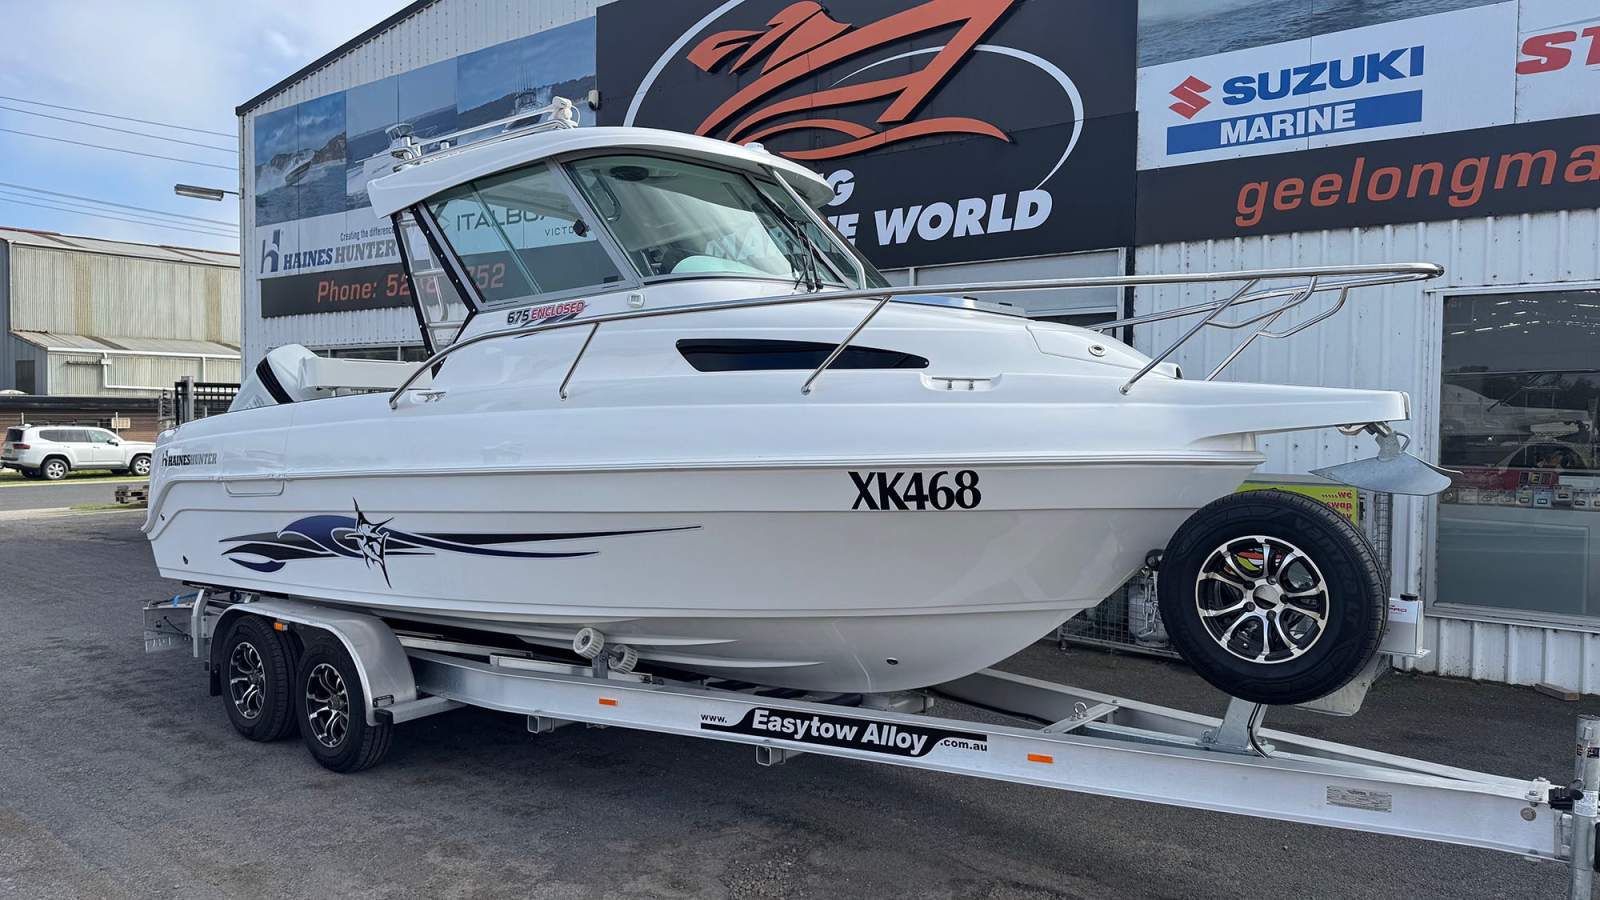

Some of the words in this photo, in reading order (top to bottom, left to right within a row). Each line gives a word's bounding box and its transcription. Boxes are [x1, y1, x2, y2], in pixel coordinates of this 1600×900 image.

[1222, 46, 1425, 106] SUZUKI
[1220, 103, 1356, 145] MARINE
[874, 188, 1053, 246] WORLD
[317, 280, 377, 304] Phone:
[507, 310, 530, 325] 675
[530, 300, 586, 321] ENCLOSED
[848, 470, 982, 511] XK468
[700, 713, 727, 724] www.
[751, 709, 858, 740] Easytow
[861, 723, 928, 756] Alloy
[939, 739, 988, 752] .com.au
